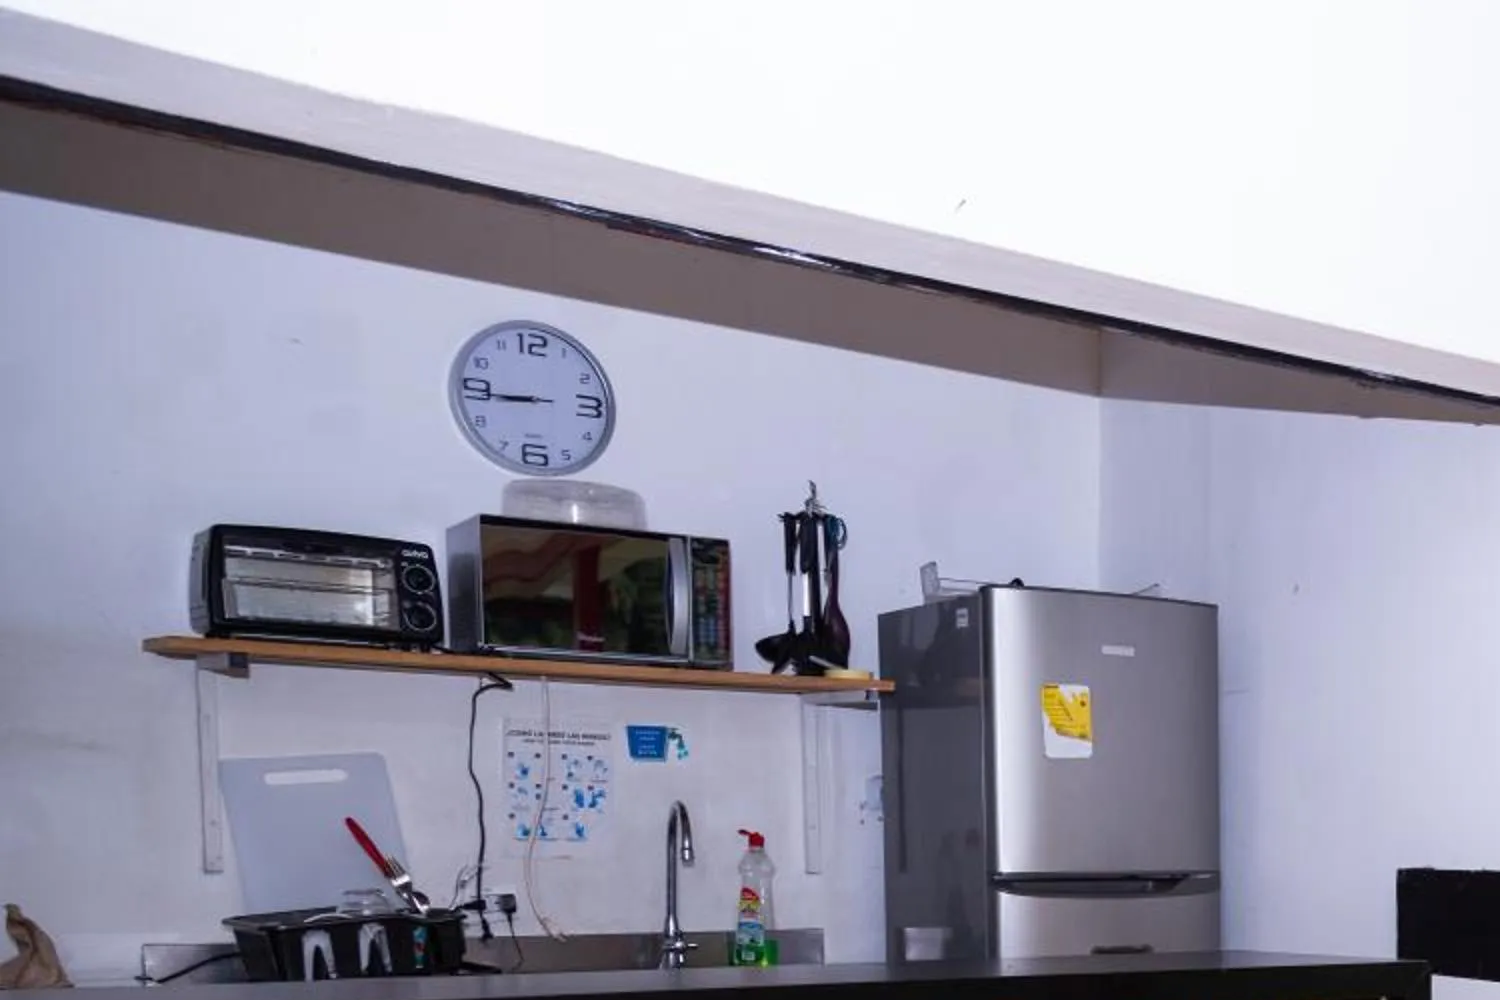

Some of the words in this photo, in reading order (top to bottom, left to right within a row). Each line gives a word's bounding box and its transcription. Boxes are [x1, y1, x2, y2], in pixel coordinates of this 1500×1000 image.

[496, 339, 506, 351] 11
[516, 332, 549, 357] 12
[561, 348, 567, 358] 1
[579, 373, 590, 384] 2
[463, 377, 491, 401] 9
[575, 394, 603, 419] 3
[475, 416, 487, 427] 8
[583, 432, 593, 441] 4
[521, 443, 549, 467] 6
[561, 449, 571, 461] 5
